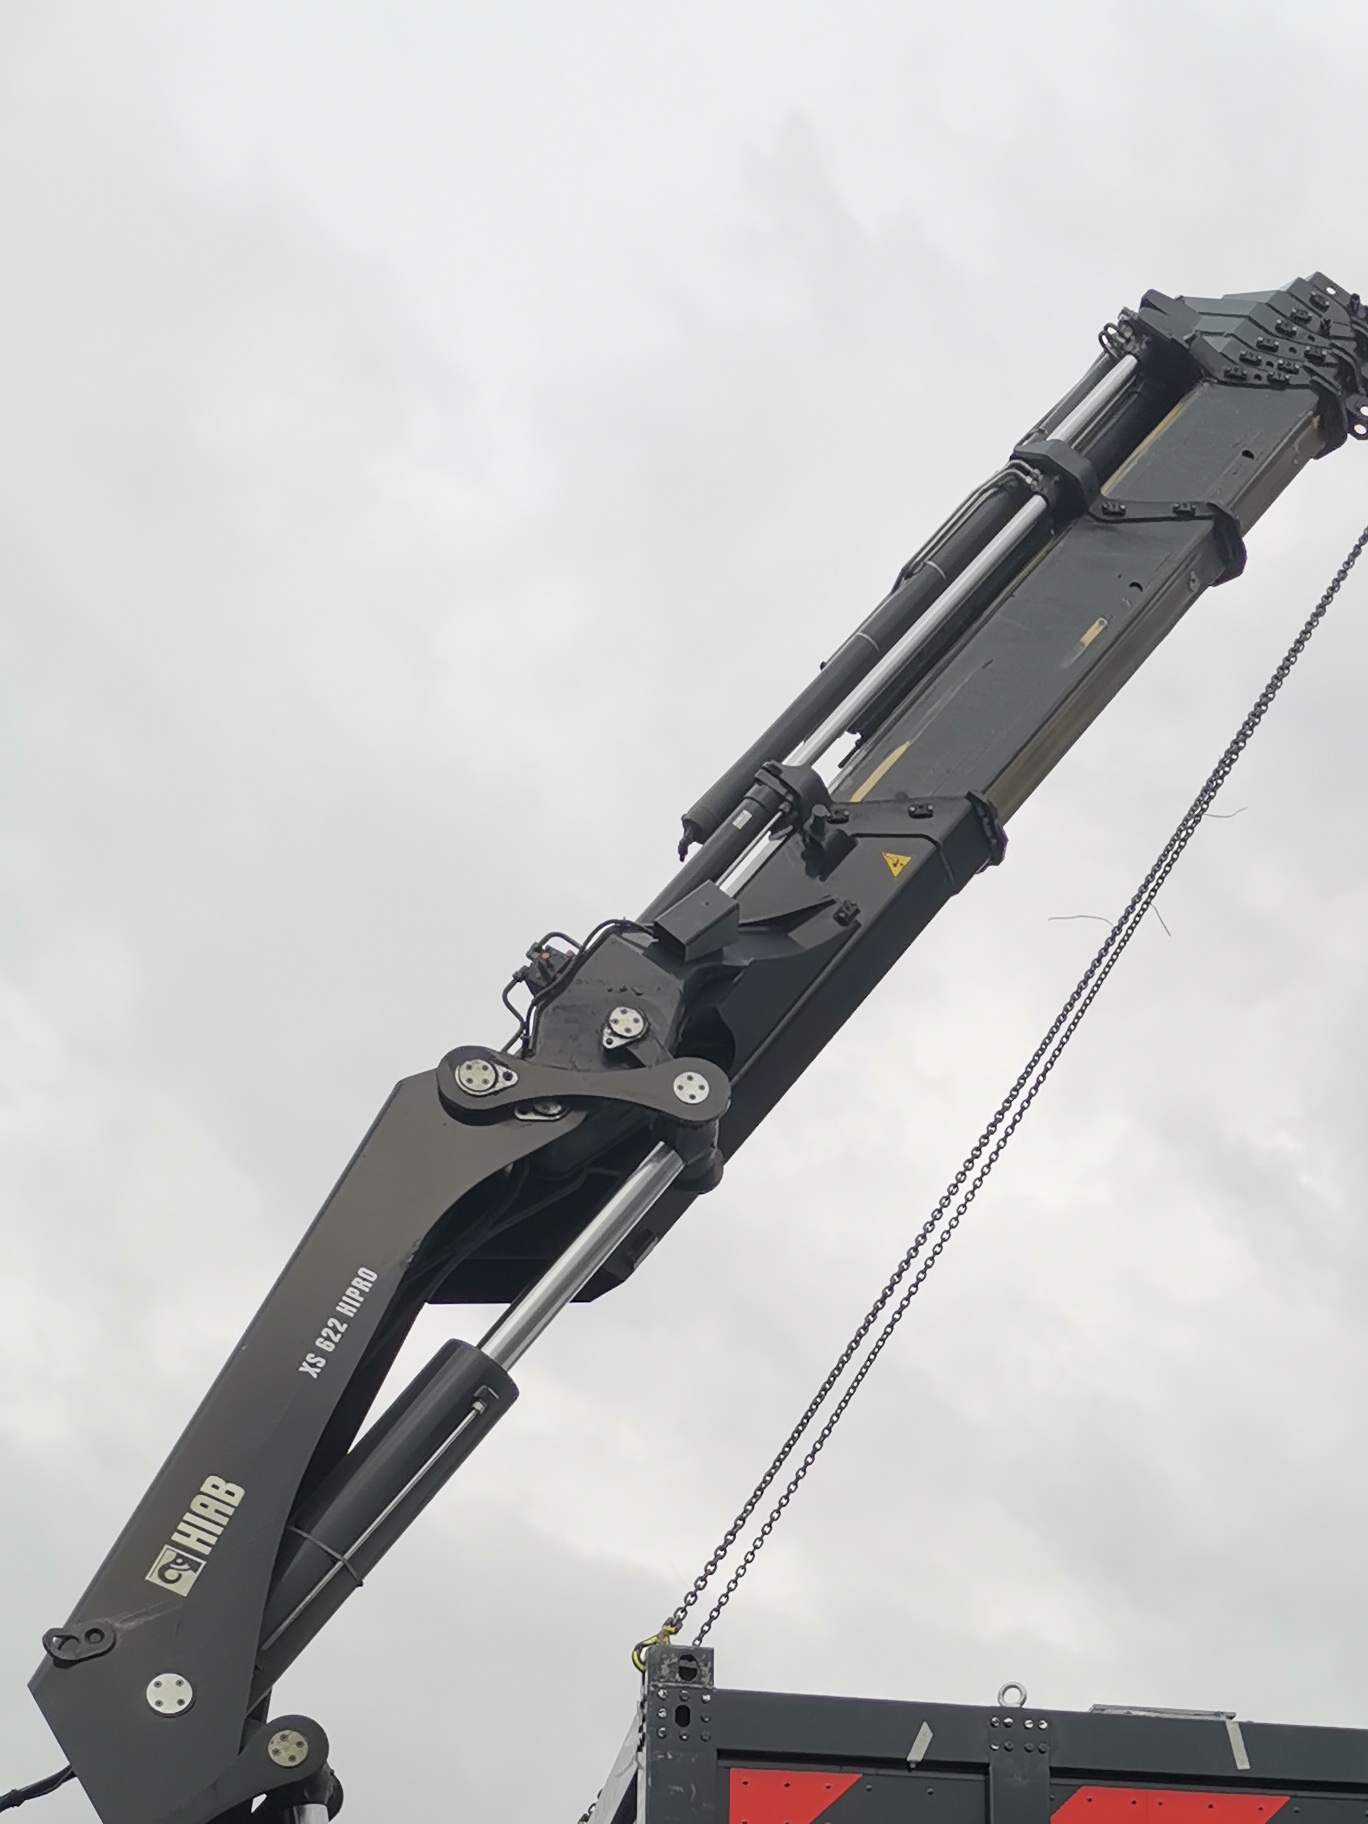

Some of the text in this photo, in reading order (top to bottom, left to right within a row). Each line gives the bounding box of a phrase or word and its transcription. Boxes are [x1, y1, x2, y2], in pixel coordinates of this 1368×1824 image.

[298, 1266, 378, 1379] XS 622 HIPRO
[170, 1475, 245, 1555] HIAB
